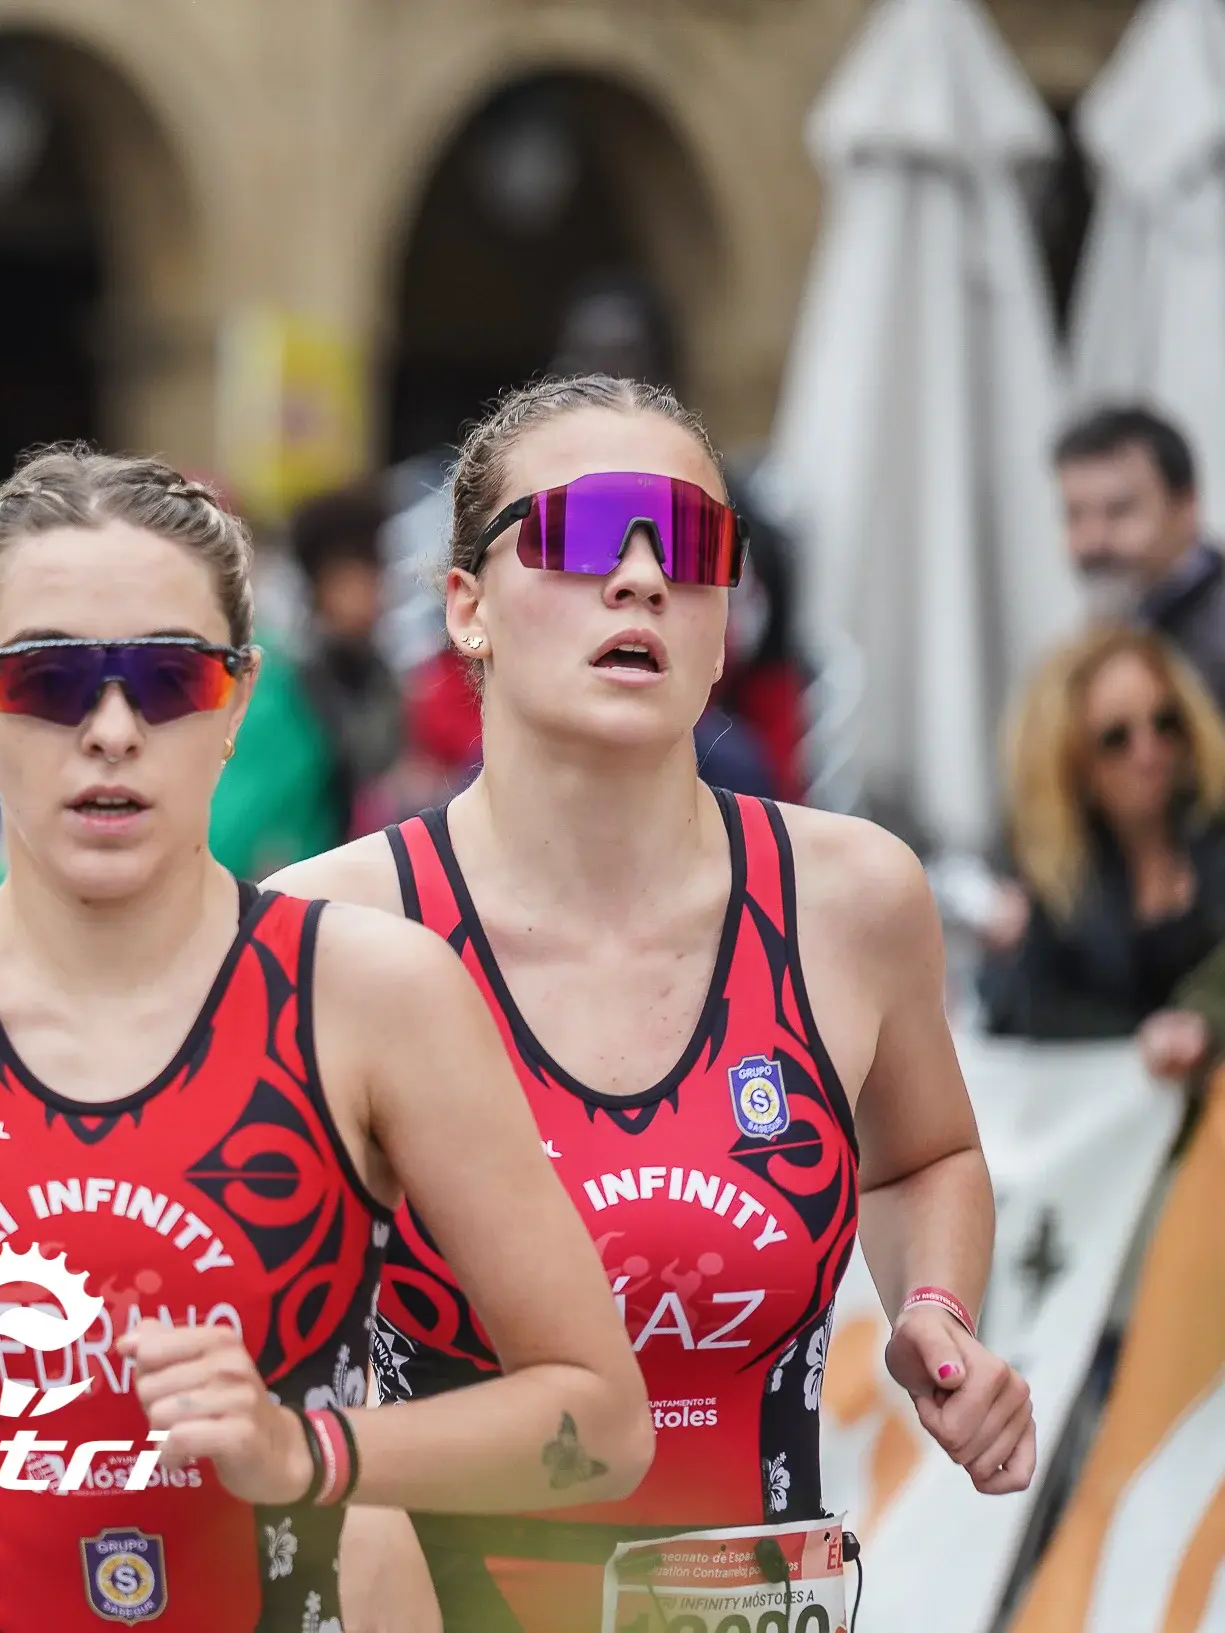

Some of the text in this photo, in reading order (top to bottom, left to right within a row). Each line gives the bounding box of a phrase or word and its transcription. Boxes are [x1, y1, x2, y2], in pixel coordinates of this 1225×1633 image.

[738, 1066, 773, 1080] GRUPO
[751, 1089, 771, 1113] S
[583, 1166, 788, 1251] INFINITY
[27, 1177, 235, 1274] INFINITY
[612, 1276, 766, 1352] ÍAZ
[649, 1397, 717, 1408] UNTAMIENTO DE
[653, 1406, 718, 1428] toles
[82, 1462, 203, 1489] ósoles
[660, 1553, 708, 1563] peonato
[729, 1551, 756, 1563] Espa
[115, 1566, 138, 1593] S
[680, 1597, 740, 1611] INFINITY
[807, 1589, 815, 1602] A
